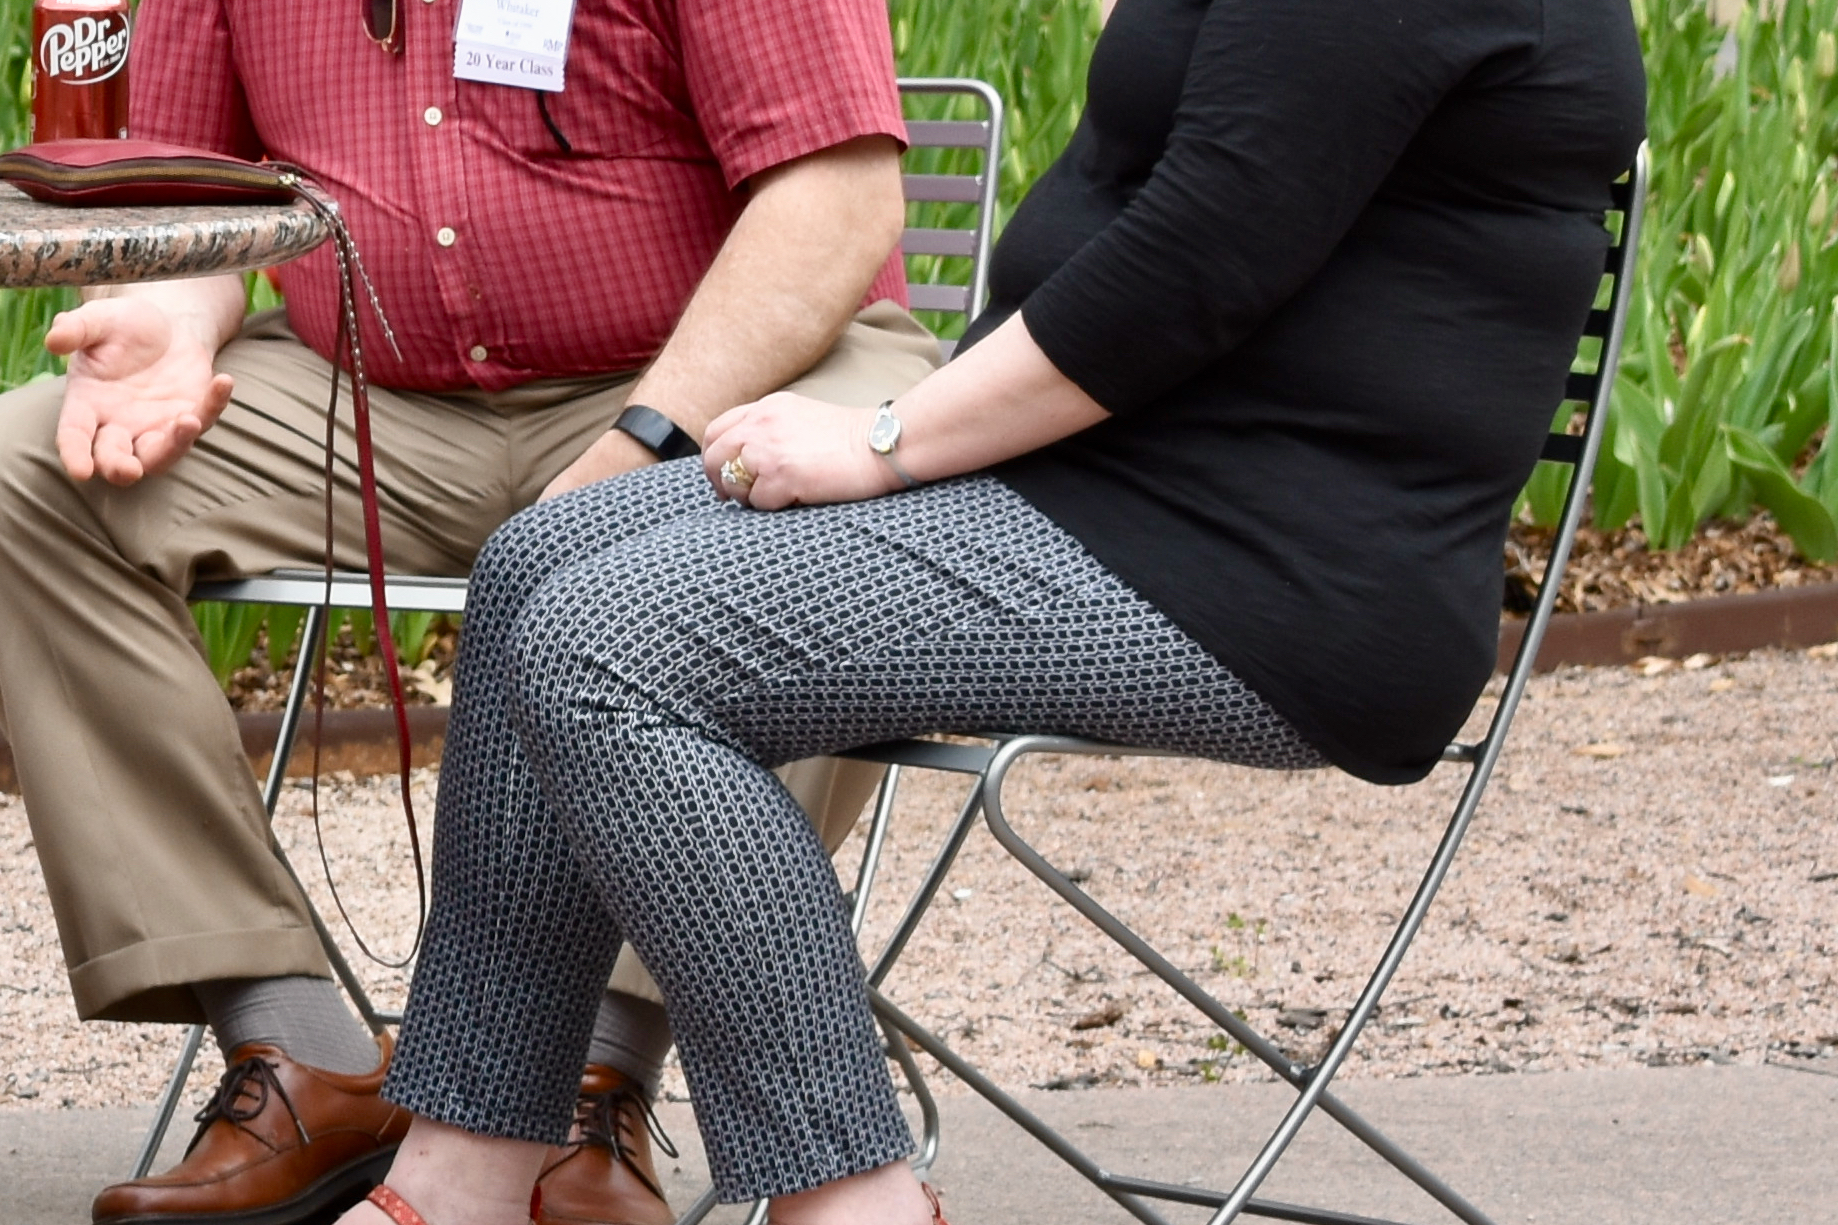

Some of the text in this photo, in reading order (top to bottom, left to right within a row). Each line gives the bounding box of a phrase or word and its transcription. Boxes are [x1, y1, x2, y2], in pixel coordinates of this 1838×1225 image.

[73, 17, 110, 49] Dr
[40, 24, 126, 77] Pepper
[466, 51, 553, 77] 20 Year Class
